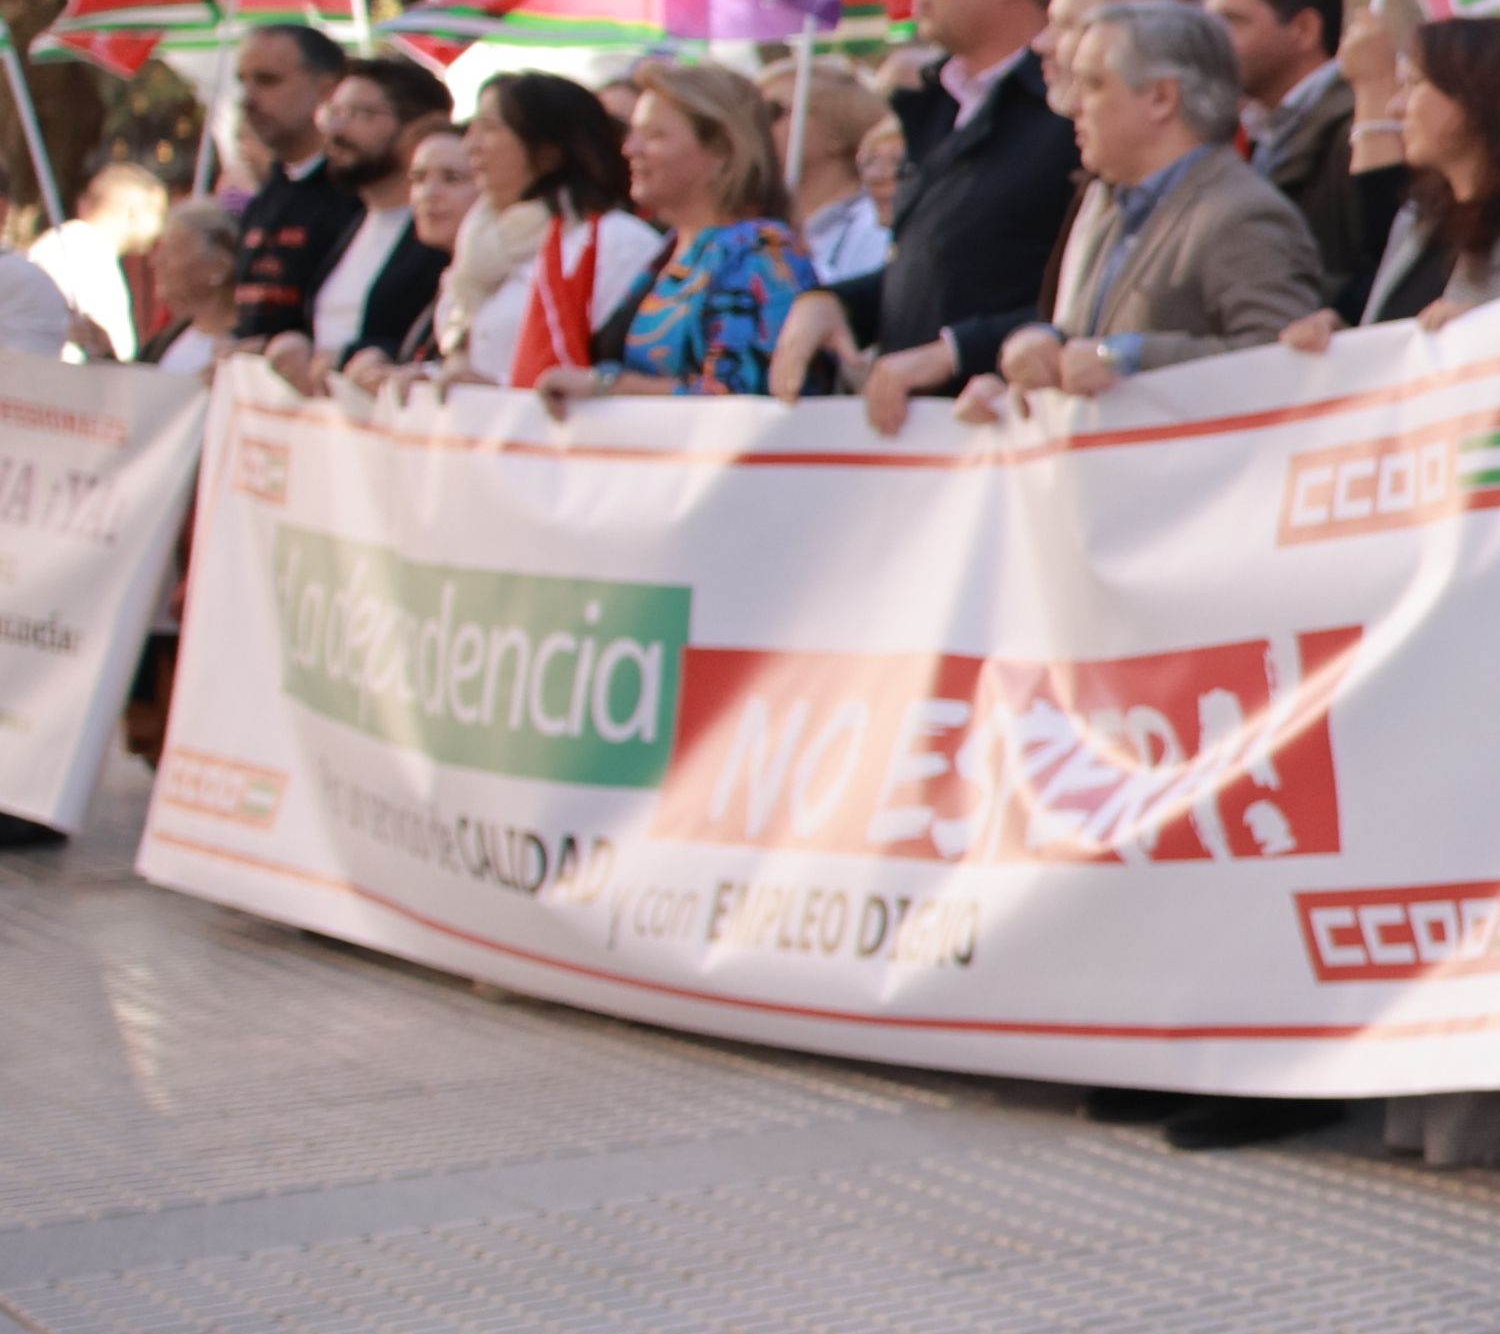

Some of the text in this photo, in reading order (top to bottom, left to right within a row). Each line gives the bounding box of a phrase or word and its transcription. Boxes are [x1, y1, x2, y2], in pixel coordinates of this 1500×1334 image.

[1290, 441, 1448, 529] CCOO
[707, 696, 869, 839] NO
[456, 815, 617, 905] CALIDAD
[634, 887, 698, 942] con
[706, 881, 847, 956] EMPLEO
[857, 892, 979, 968] DIGNO
[1309, 897, 1497, 968] CCOO
